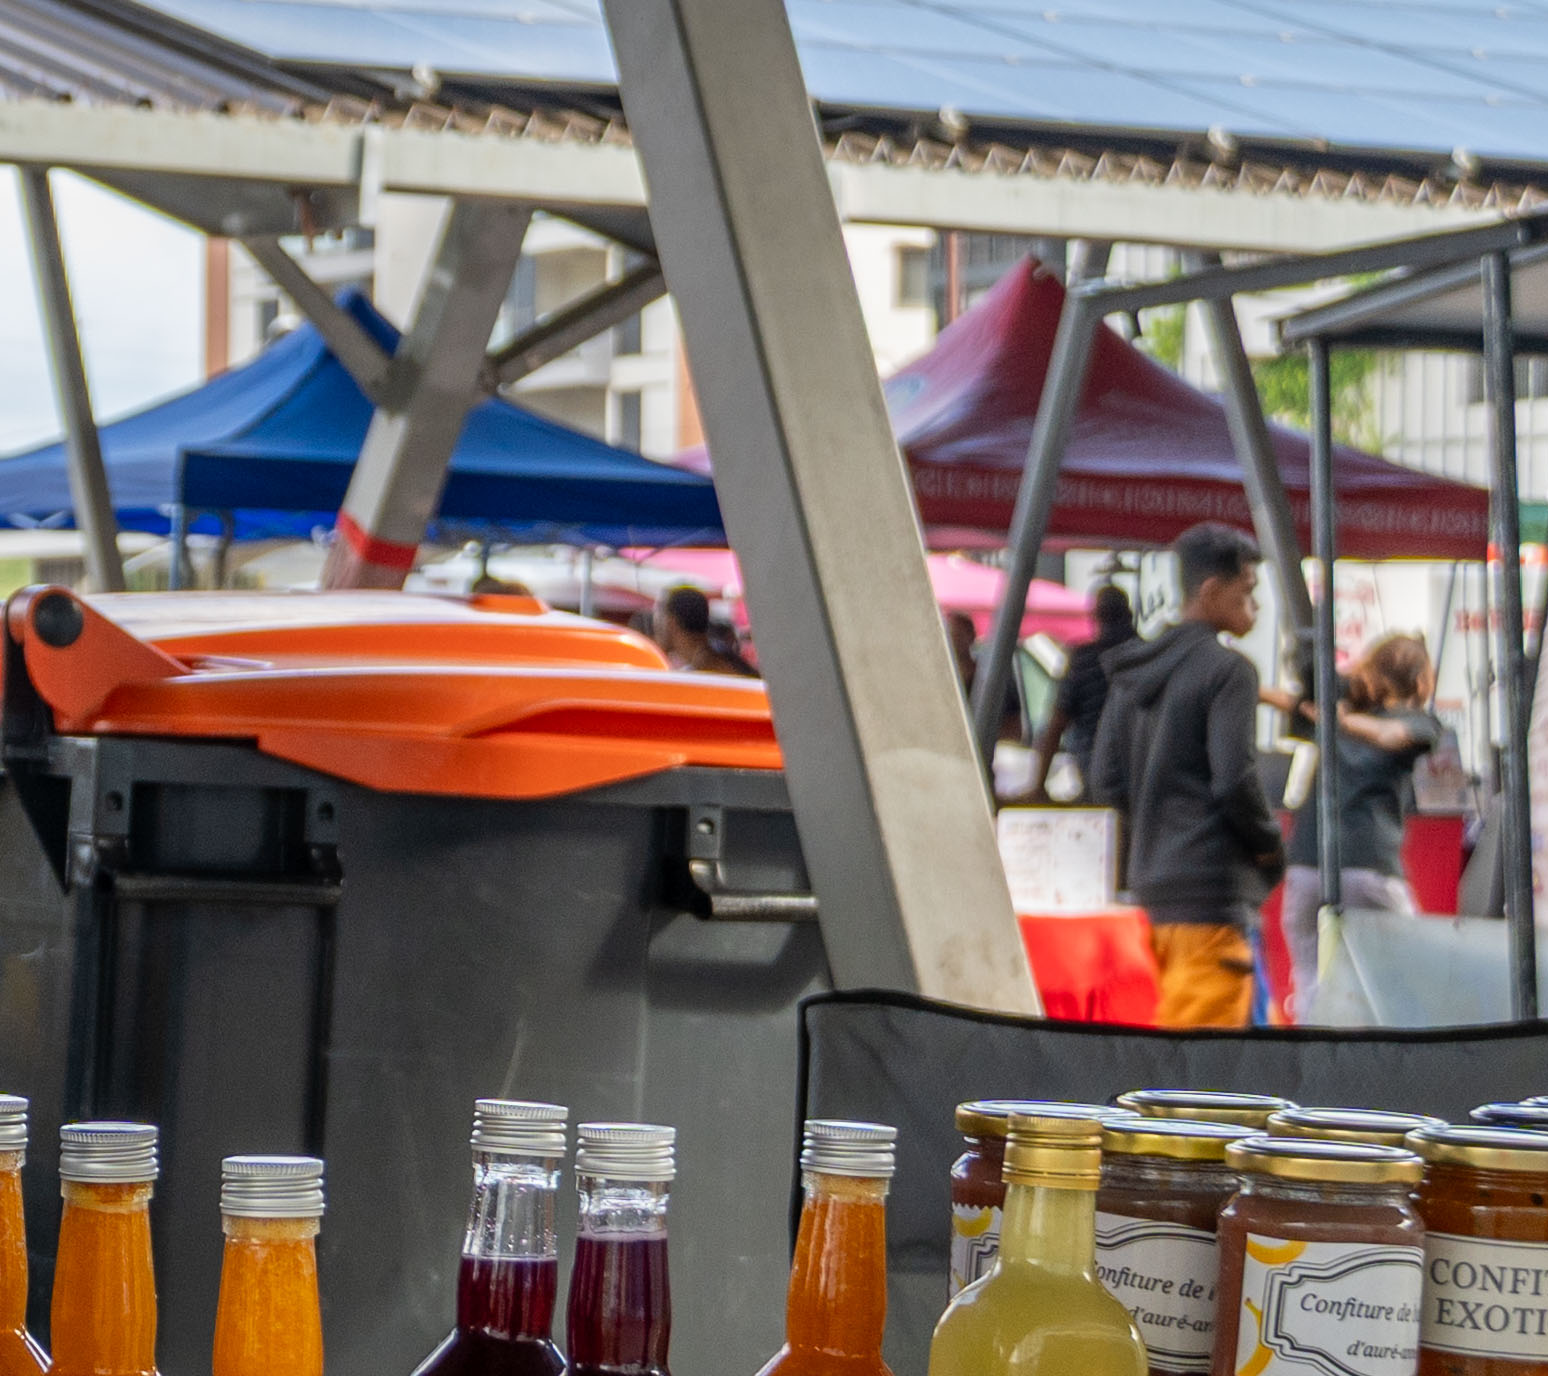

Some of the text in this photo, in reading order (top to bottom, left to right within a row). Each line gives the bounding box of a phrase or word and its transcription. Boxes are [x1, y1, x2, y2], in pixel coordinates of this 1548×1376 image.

[1094, 1261, 1205, 1299] onfiture de
[1300, 1293, 1394, 1323] Confiture
